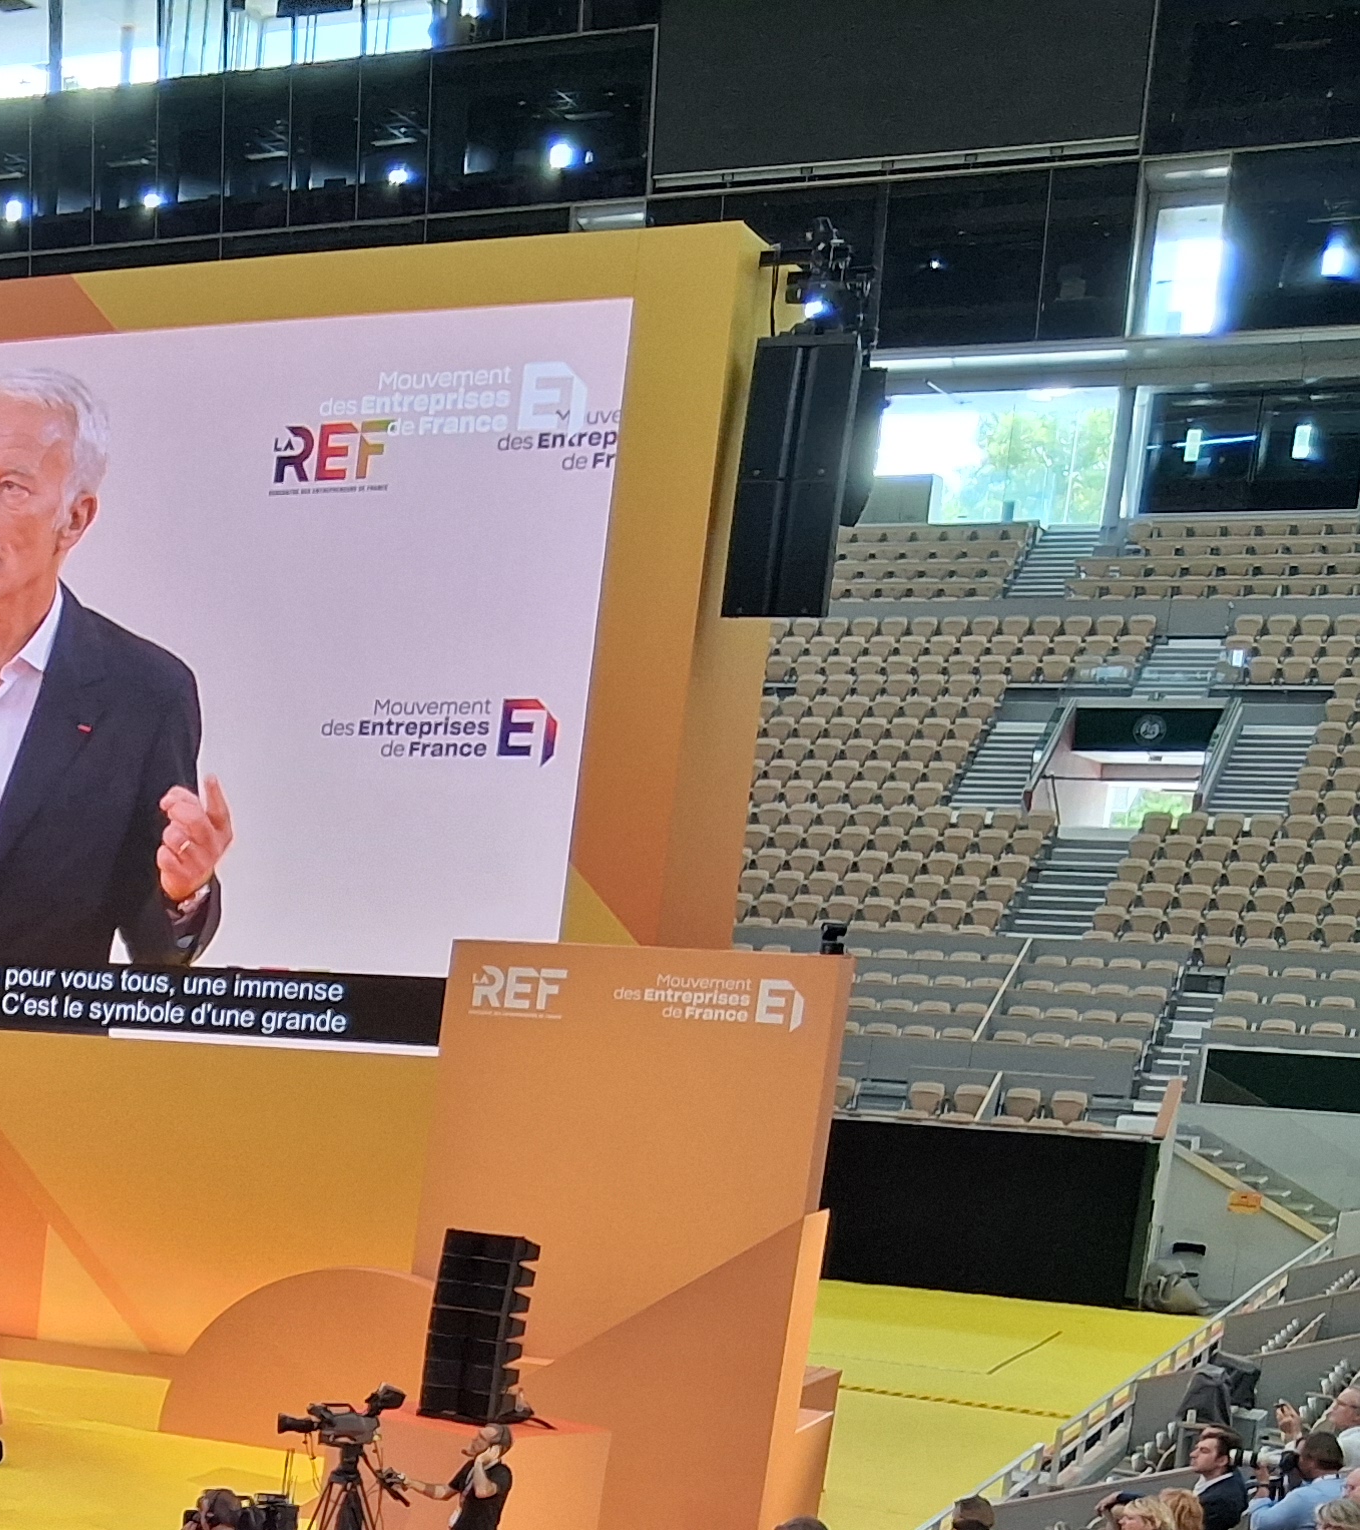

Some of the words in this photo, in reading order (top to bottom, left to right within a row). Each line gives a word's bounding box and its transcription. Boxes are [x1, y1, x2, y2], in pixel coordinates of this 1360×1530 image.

[379, 366, 512, 391] Mouvement
[320, 397, 357, 418] des
[361, 387, 511, 416] Entreprises
[386, 419, 415, 436] de
[418, 413, 508, 435] France
[273, 420, 396, 483] REF
[497, 432, 534, 452] des
[561, 452, 589, 472] de
[373, 698, 492, 716] Mouvement
[321, 719, 355, 737] des
[358, 716, 491, 740] Entreprises
[380, 740, 406, 758] de
[408, 739, 488, 758] France
[5, 967, 56, 991] pour
[61, 970, 114, 990] vous
[120, 969, 176, 997] tous,
[183, 978, 228, 997] une
[233, 975, 345, 1002] immense
[471, 964, 569, 1011] REF
[656, 972, 753, 992] Mouvement
[613, 985, 642, 1001] des
[643, 986, 751, 1008] Entreprises
[1, 992, 59, 1018] C'est
[63, 995, 84, 1019] le
[88, 1000, 186, 1026] symbole
[191, 1002, 256, 1028] d'une
[261, 1009, 348, 1036] grande
[662, 1004, 683, 1020] de
[684, 1005, 749, 1023] France
